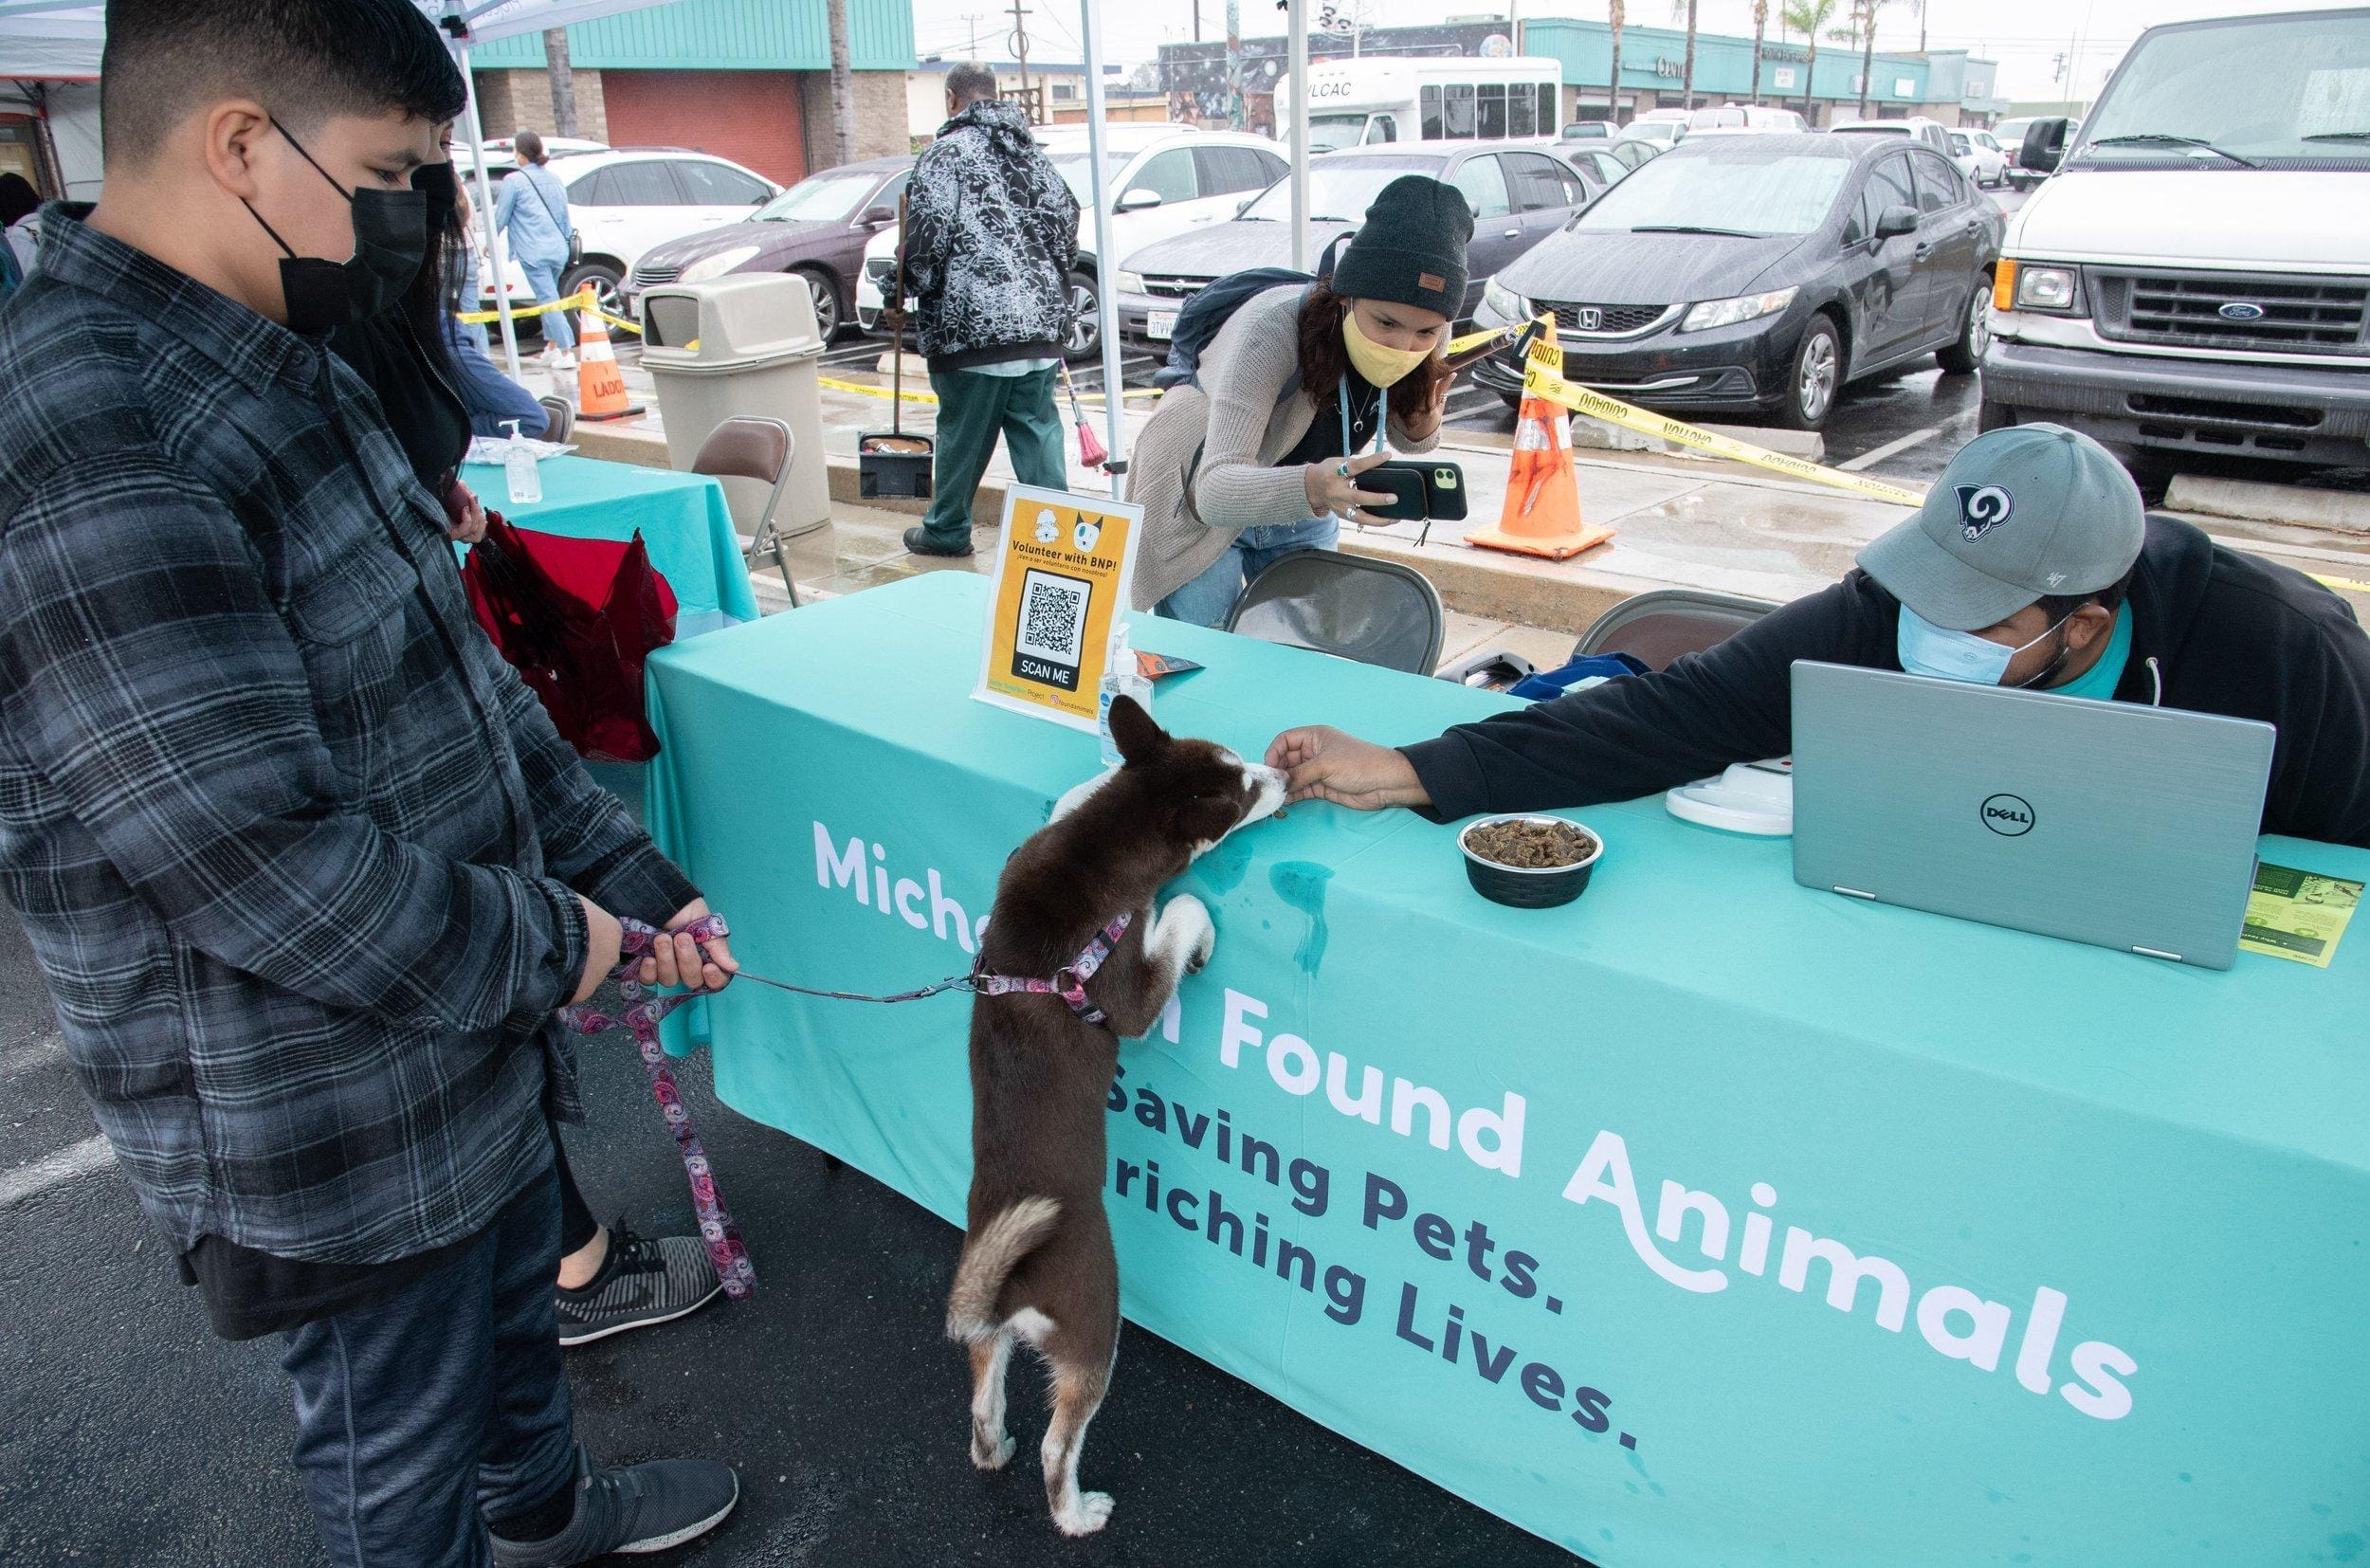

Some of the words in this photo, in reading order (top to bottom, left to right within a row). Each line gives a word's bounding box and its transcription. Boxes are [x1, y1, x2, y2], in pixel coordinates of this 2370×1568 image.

[1656, 55, 1686, 78] CENTE
[1578, 392, 1628, 419] CUIDADO
[1662, 420, 1712, 445] CAUTION
[1012, 539, 1062, 560] Volunteer
[1065, 553, 1087, 566] with
[1090, 556, 1118, 572] BNP!
[1043, 559, 1069, 570] voluntario
[1021, 660, 1051, 680] SCAN
[1052, 670, 1070, 684] ME
[1027, 689, 1045, 701] Project
[1986, 807, 2029, 824] DELL
[812, 821, 991, 954] Mich
[1220, 988, 1526, 1178] Found
[1561, 1129, 2139, 1421] Animals
[1363, 1171, 1564, 1316] Pets.
[1104, 1157, 1367, 1326] riching
[1395, 1282, 1638, 1451] Lives.
